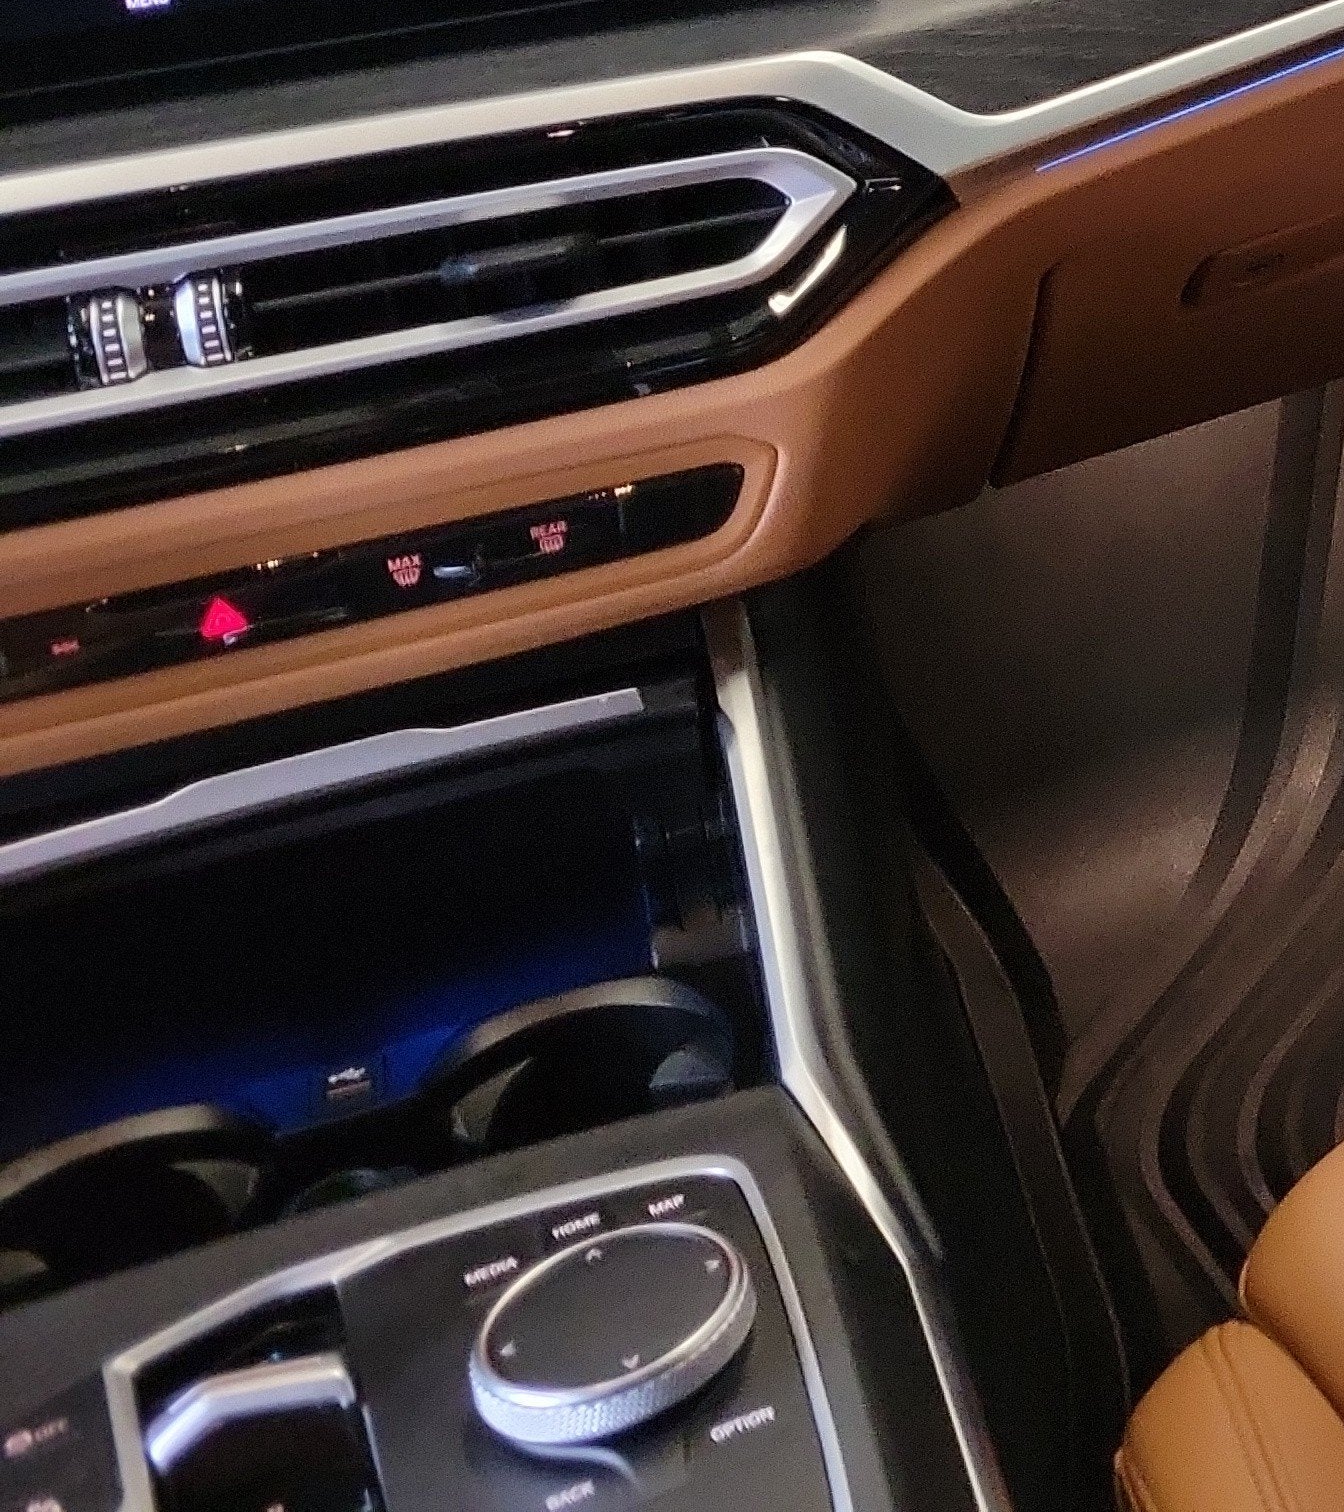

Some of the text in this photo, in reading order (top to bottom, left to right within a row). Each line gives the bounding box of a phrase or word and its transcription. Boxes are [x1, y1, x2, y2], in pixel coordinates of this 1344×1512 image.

[530, 520, 567, 538] REAR
[387, 553, 421, 572] MAX
[649, 1193, 685, 1217] MAP
[552, 1212, 600, 1239] HOME
[464, 1256, 518, 1286] MEDIA
[710, 1405, 776, 1442] OPTION
[545, 1479, 594, 1511] BACK
